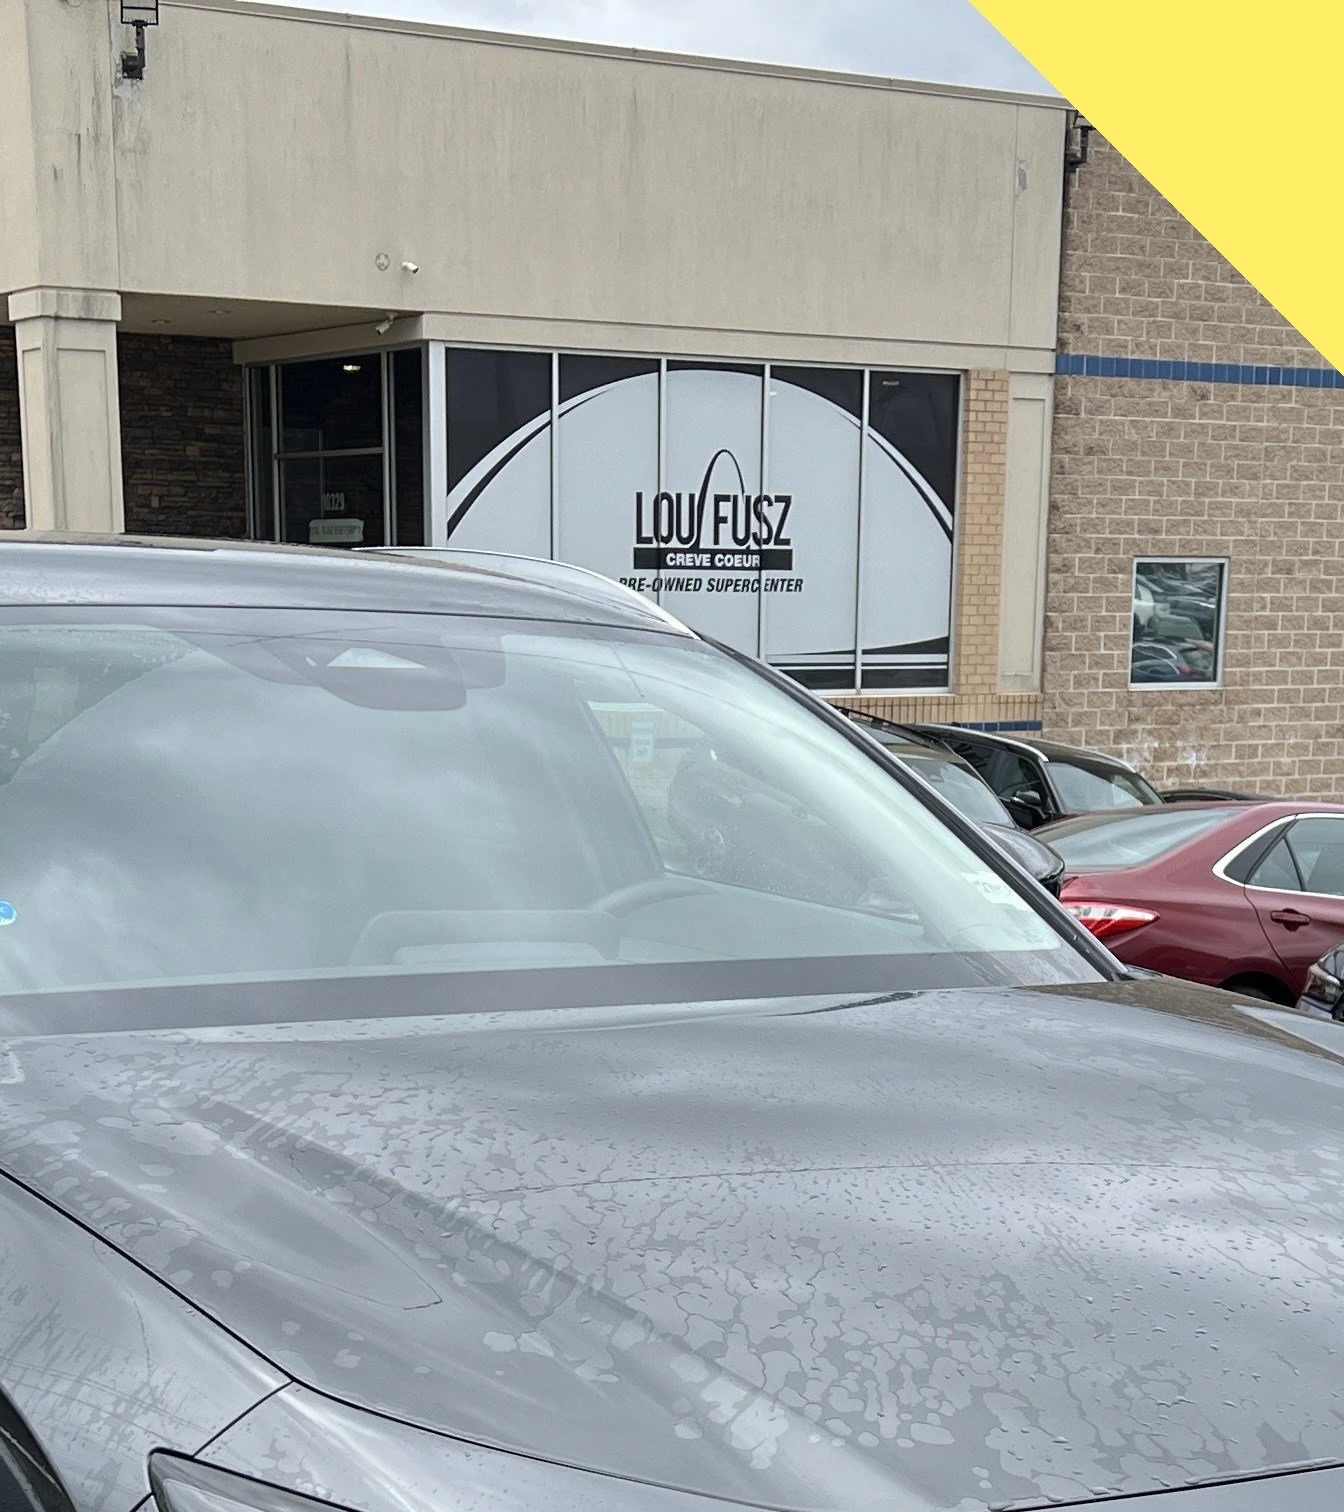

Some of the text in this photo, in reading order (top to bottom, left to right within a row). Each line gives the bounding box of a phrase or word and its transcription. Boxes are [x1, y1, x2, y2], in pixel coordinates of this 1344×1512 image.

[635, 491, 793, 547] LOU FUSZ
[666, 553, 761, 568] CREVE COEUR
[619, 577, 804, 593] PRE-OWNED SUPERCENTER
